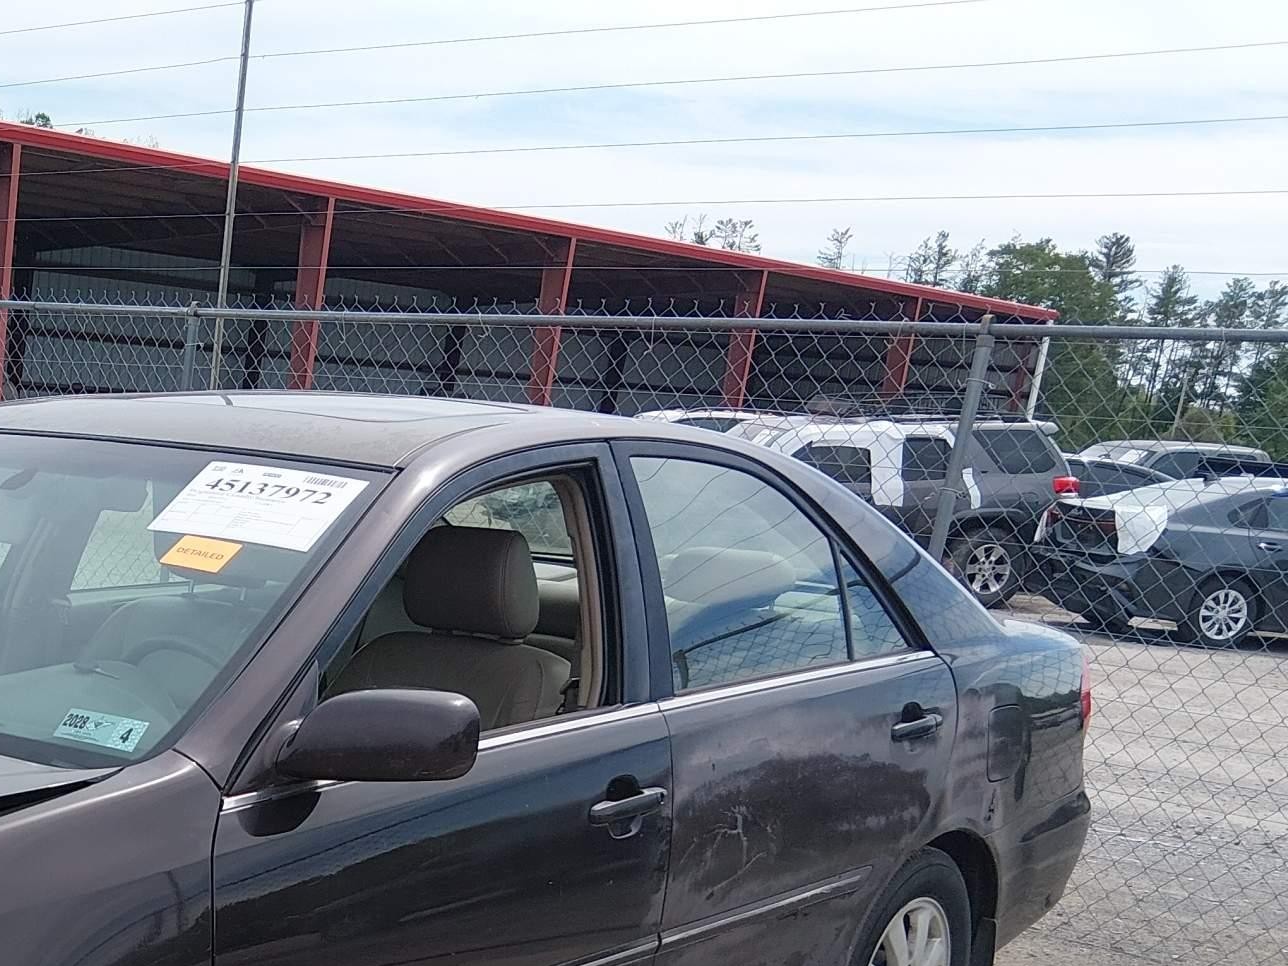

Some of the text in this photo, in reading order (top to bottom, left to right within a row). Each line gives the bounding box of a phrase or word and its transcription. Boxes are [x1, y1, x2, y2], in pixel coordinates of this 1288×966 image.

[205, 477, 332, 505] 45137972
[176, 546, 225, 560] DETAILED
[120, 728, 134, 743] 4
